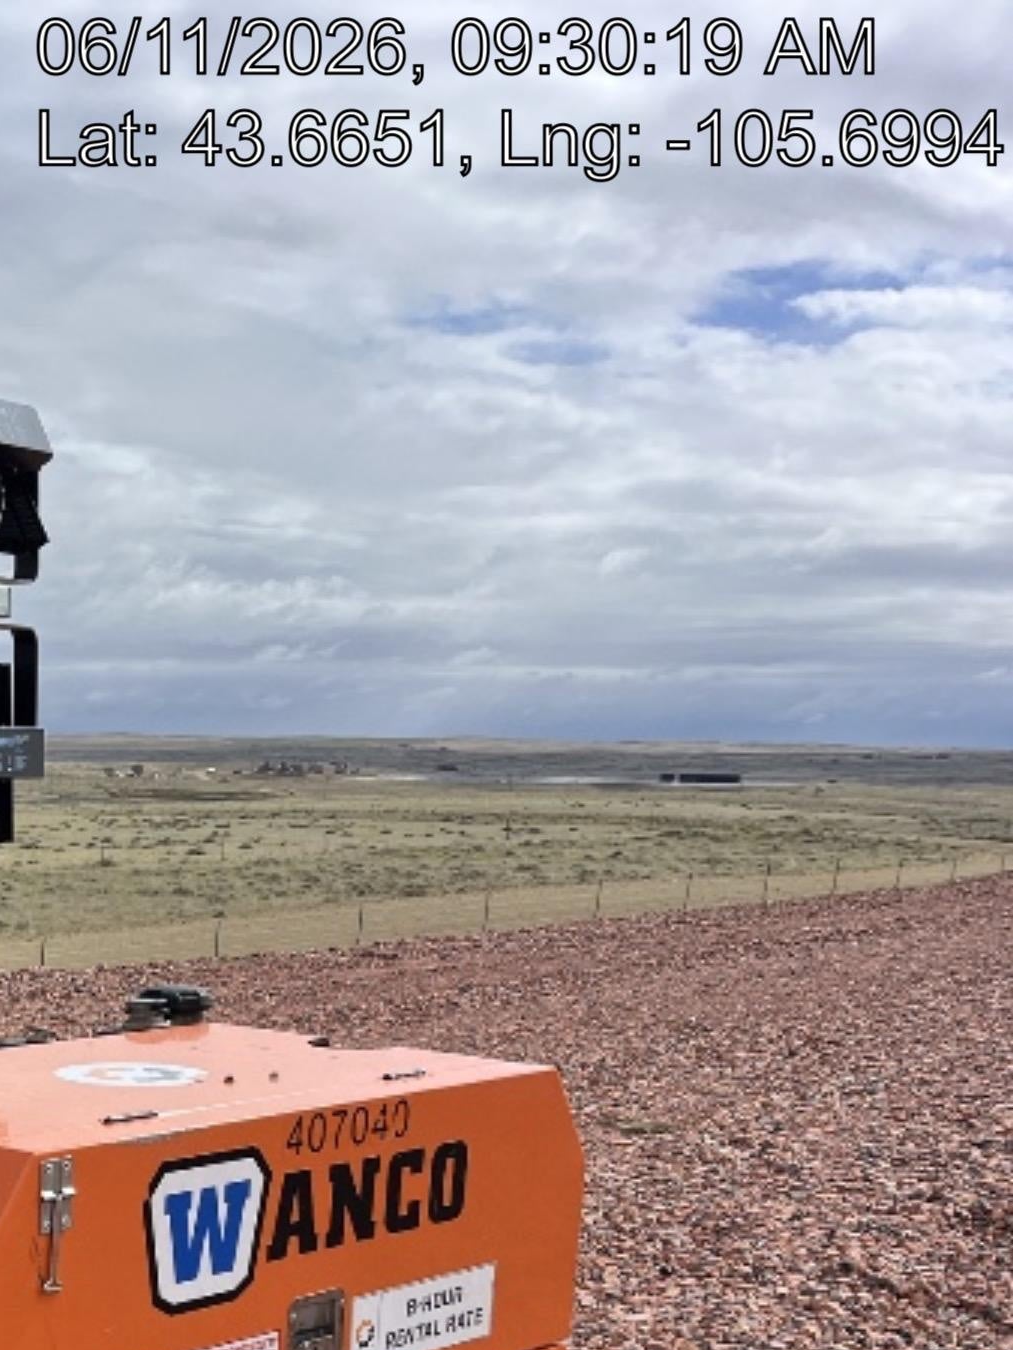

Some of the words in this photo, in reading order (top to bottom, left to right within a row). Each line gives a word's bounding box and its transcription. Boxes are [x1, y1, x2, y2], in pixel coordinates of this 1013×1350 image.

[286, 1098, 411, 1155] 407040
[163, 1140, 468, 1285] WANCO
[385, 1319, 442, 1350] RENTAL
[445, 1306, 484, 1333] RATE
